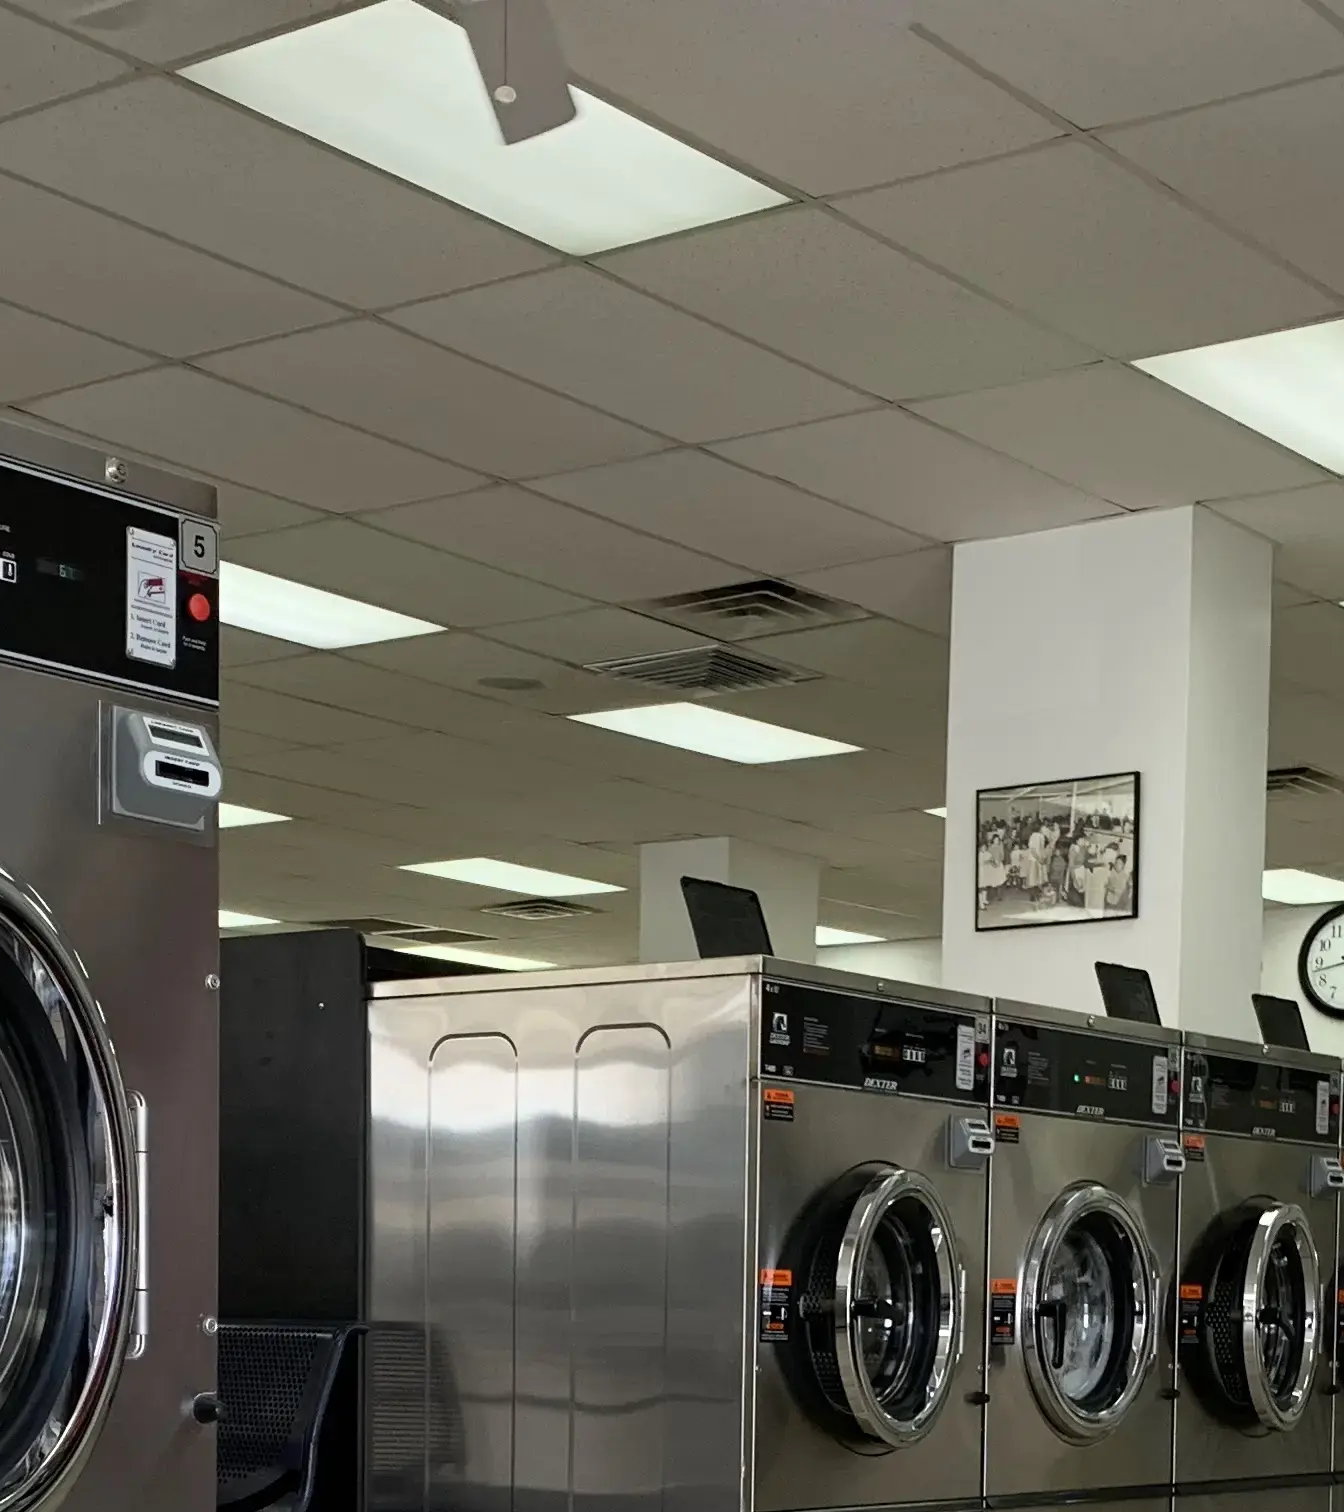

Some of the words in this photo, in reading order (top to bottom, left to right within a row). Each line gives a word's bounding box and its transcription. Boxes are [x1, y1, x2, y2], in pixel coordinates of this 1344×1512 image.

[193, 535, 205, 559] 5
[137, 614, 152, 625] Insert
[158, 639, 171, 649] Card
[1332, 924, 1342, 938] 11
[1319, 938, 1332, 952] 10
[1315, 956, 1324, 970] 9
[1319, 973, 1327, 987] 8
[1330, 985, 1337, 999] 7
[863, 1077, 898, 1091] DEXTER
